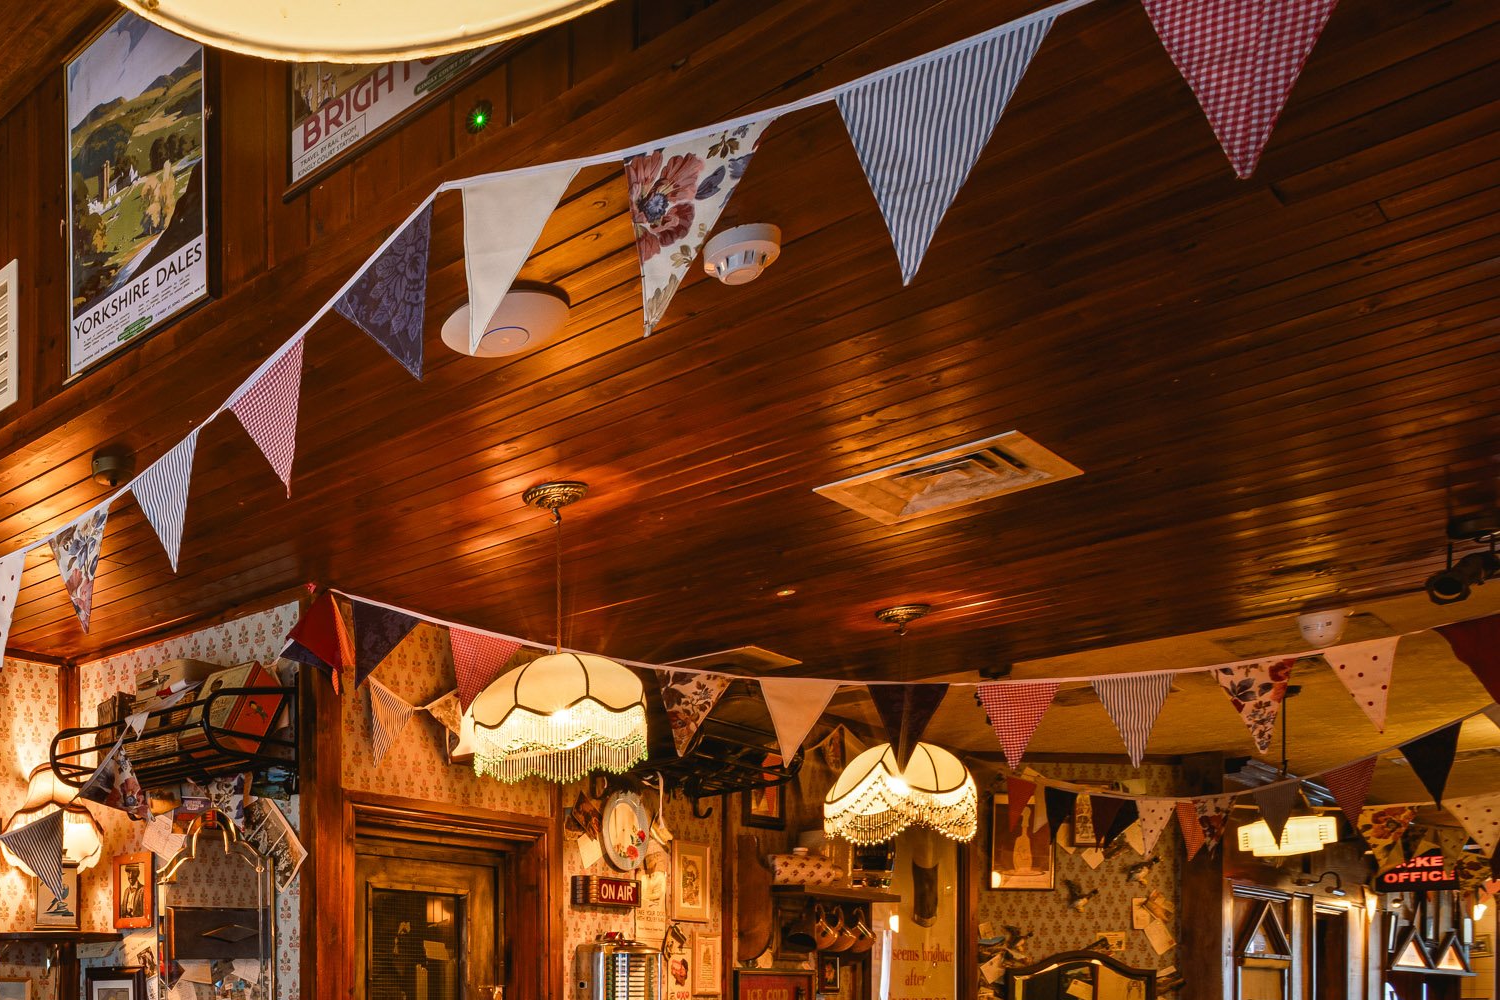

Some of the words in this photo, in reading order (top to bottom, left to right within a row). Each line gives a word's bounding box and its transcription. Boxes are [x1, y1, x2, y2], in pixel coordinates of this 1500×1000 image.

[298, 161, 316, 177] KINGLY
[316, 148, 336, 165] COURT
[336, 131, 360, 152] STATION
[300, 151, 319, 167] TRAVEL
[320, 145, 328, 154] BY
[327, 138, 339, 149] RAIL
[340, 125, 357, 140] FROM
[73, 277, 150, 340] YORKSHIRE
[156, 242, 203, 288] DALES
[601, 883, 616, 900] ON
[617, 884, 633, 902] AIR
[892, 948, 919, 961] seems
[921, 943, 954, 967] brighter
[905, 967, 926, 986] after
[676, 991, 690, 1000] OXO
